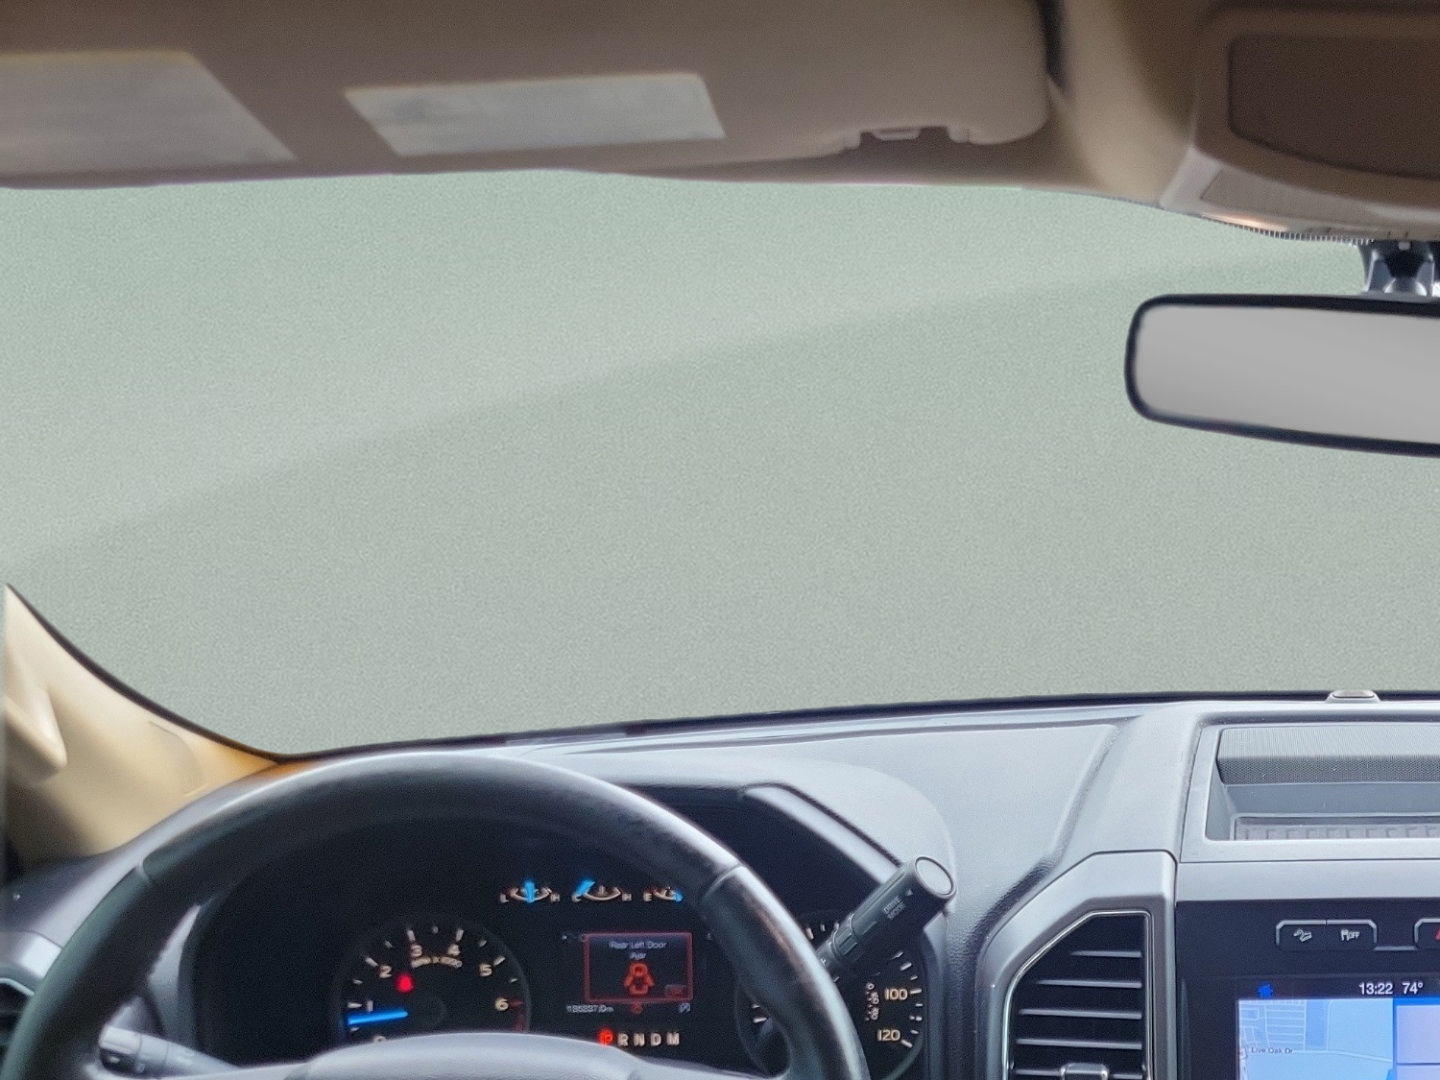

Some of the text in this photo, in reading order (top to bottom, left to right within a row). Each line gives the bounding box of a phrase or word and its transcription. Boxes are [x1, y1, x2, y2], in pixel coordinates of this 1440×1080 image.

[411, 945, 422, 957] 3
[448, 944, 460, 956] 4
[648, 941, 667, 949] Door
[380, 965, 392, 978] 2
[479, 963, 492, 976] 5
[885, 988, 908, 1000] 100
[1359, 982, 1393, 995] 13:22
[495, 998, 509, 1011] 6
[617, 1032, 629, 1045] R
[633, 1032, 645, 1045] N
[650, 1032, 662, 1045] D
[666, 1031, 680, 1045] M
[877, 1029, 901, 1041] 120
